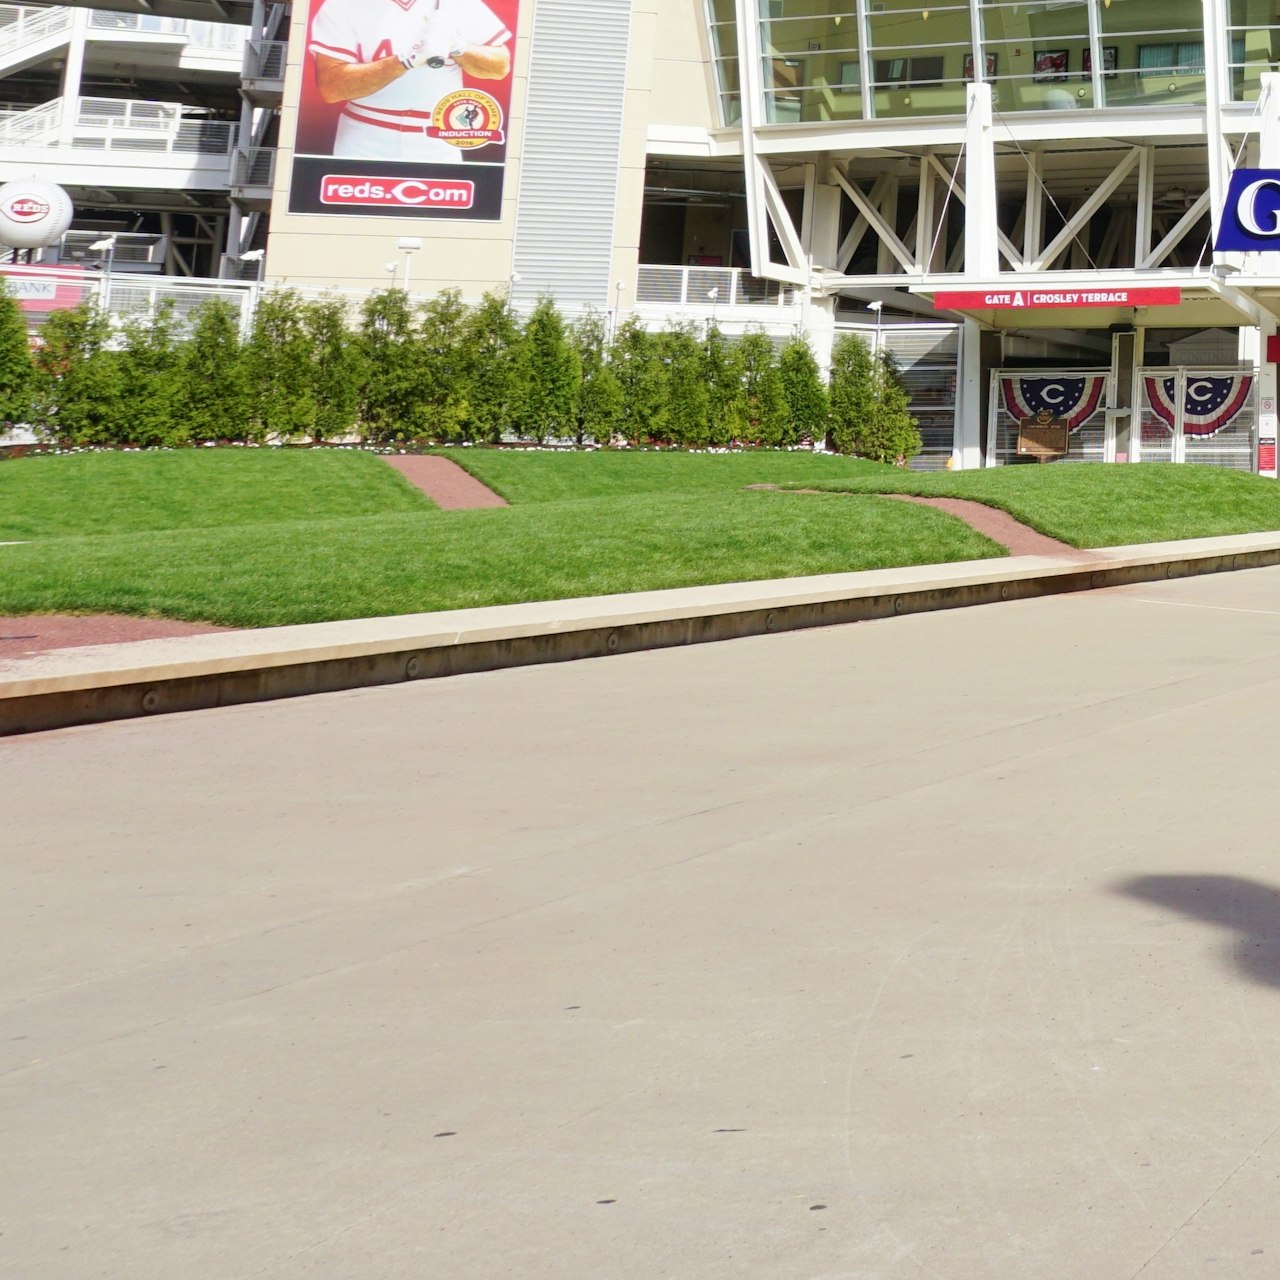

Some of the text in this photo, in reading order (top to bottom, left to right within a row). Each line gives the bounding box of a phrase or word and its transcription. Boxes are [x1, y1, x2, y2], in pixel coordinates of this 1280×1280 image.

[12, 202, 49, 213] REDS
[984, 291, 1128, 307] GATE A CROSLEY TERRACE
